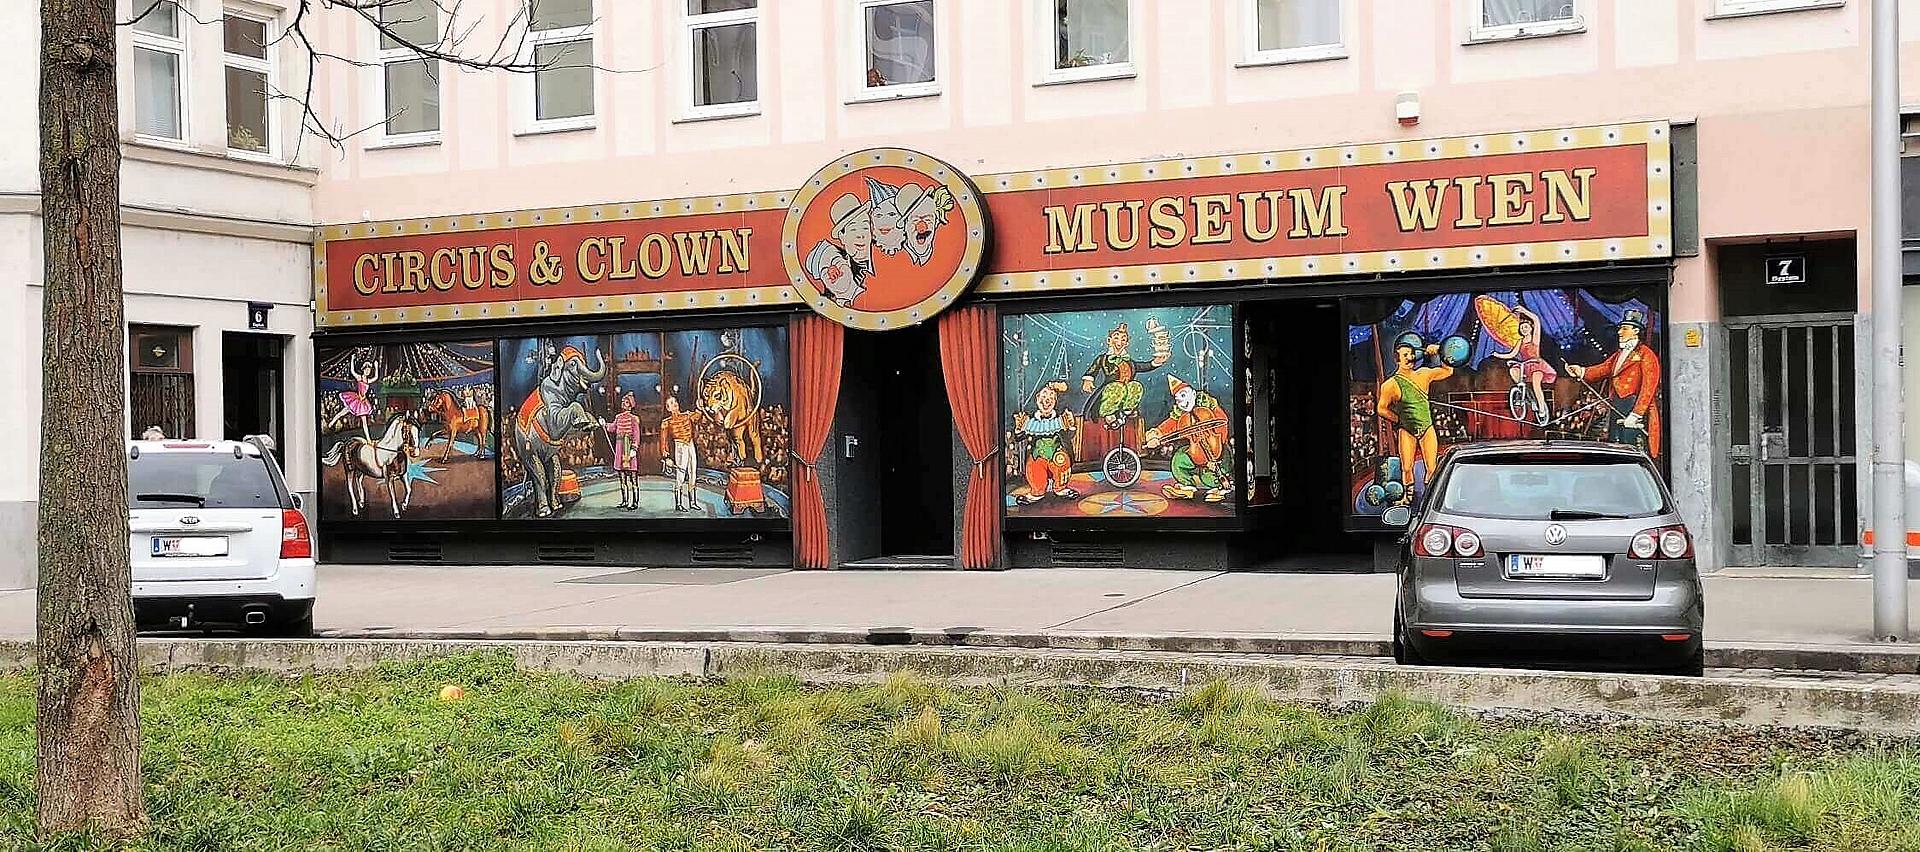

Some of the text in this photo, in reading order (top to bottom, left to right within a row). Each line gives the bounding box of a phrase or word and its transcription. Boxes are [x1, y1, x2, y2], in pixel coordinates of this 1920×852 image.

[352, 166, 1597, 296] CIRCUS & CLOWN MUSEUM WIEN
[1778, 259, 1793, 276] 7
[254, 310, 263, 323] 6
